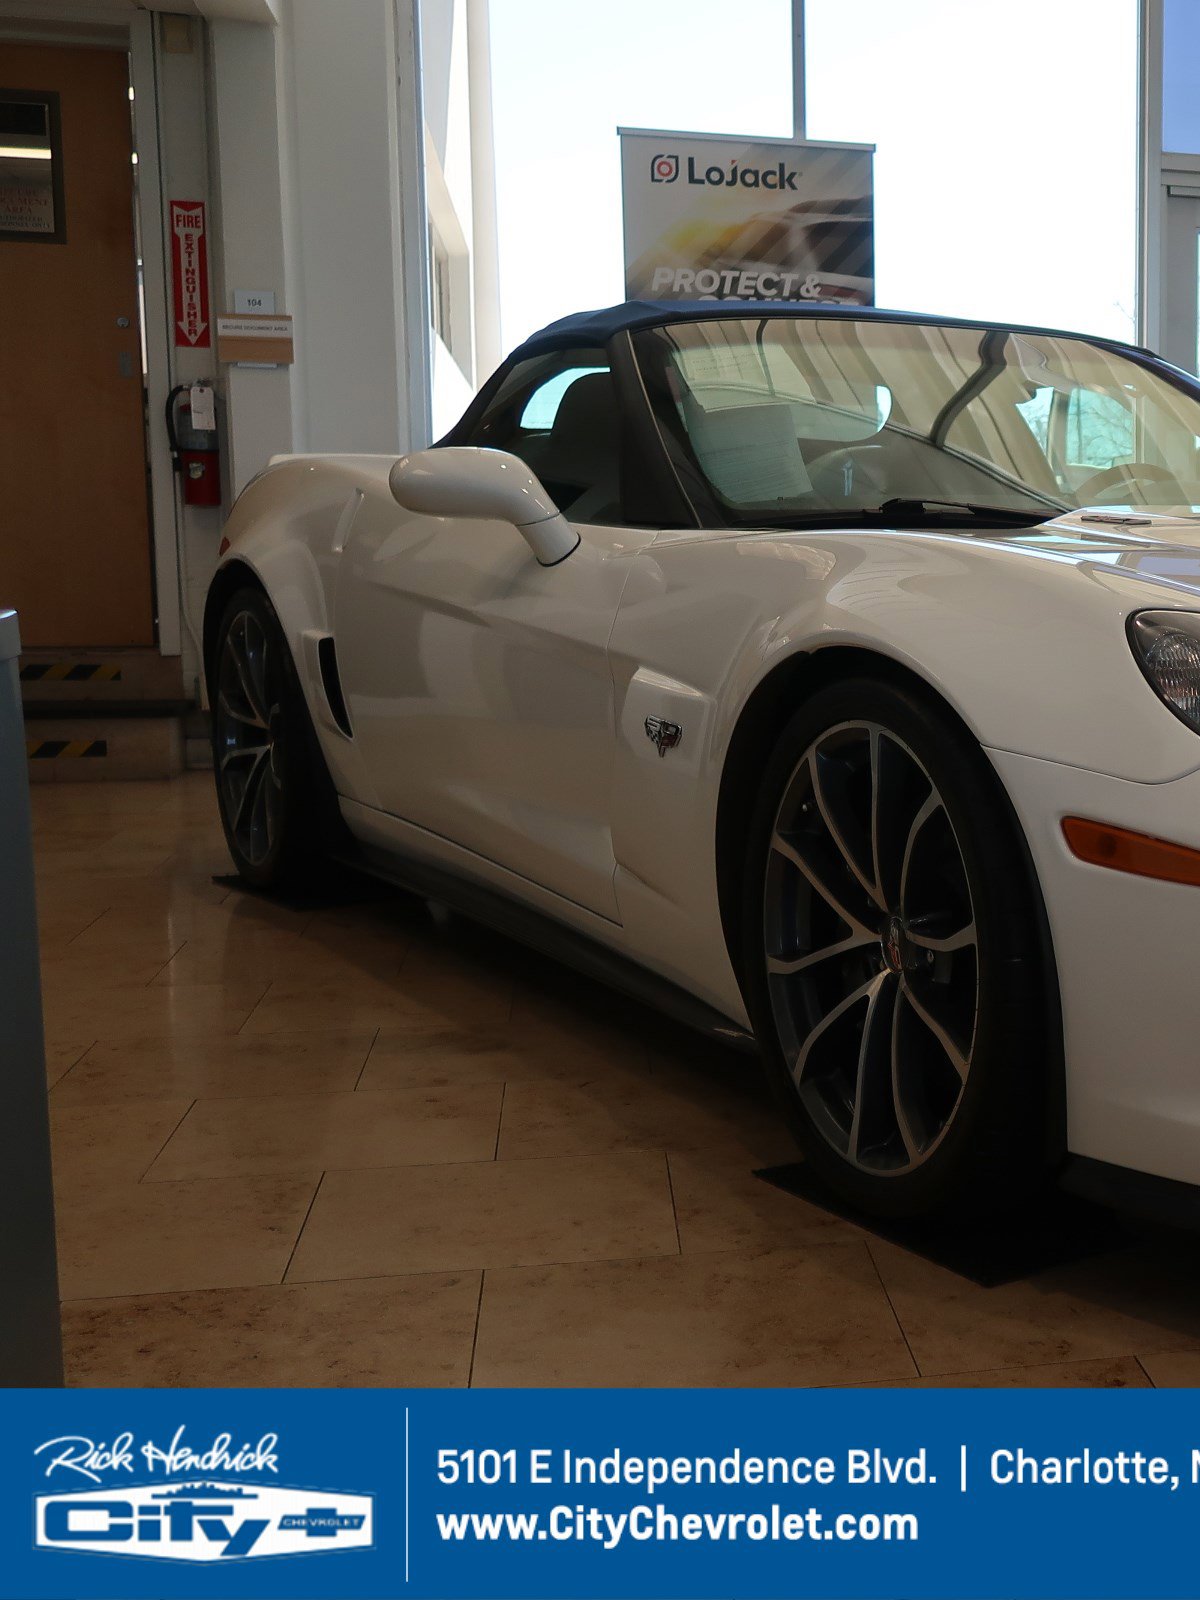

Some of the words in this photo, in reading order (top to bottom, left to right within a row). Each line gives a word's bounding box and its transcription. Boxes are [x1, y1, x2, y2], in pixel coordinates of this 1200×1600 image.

[176, 214, 202, 228] FIRE
[184, 233, 198, 337] EXTINGUISHER
[651, 267, 799, 297] PROTECT
[800, 272, 822, 298] &
[247, 299, 262, 307] 104
